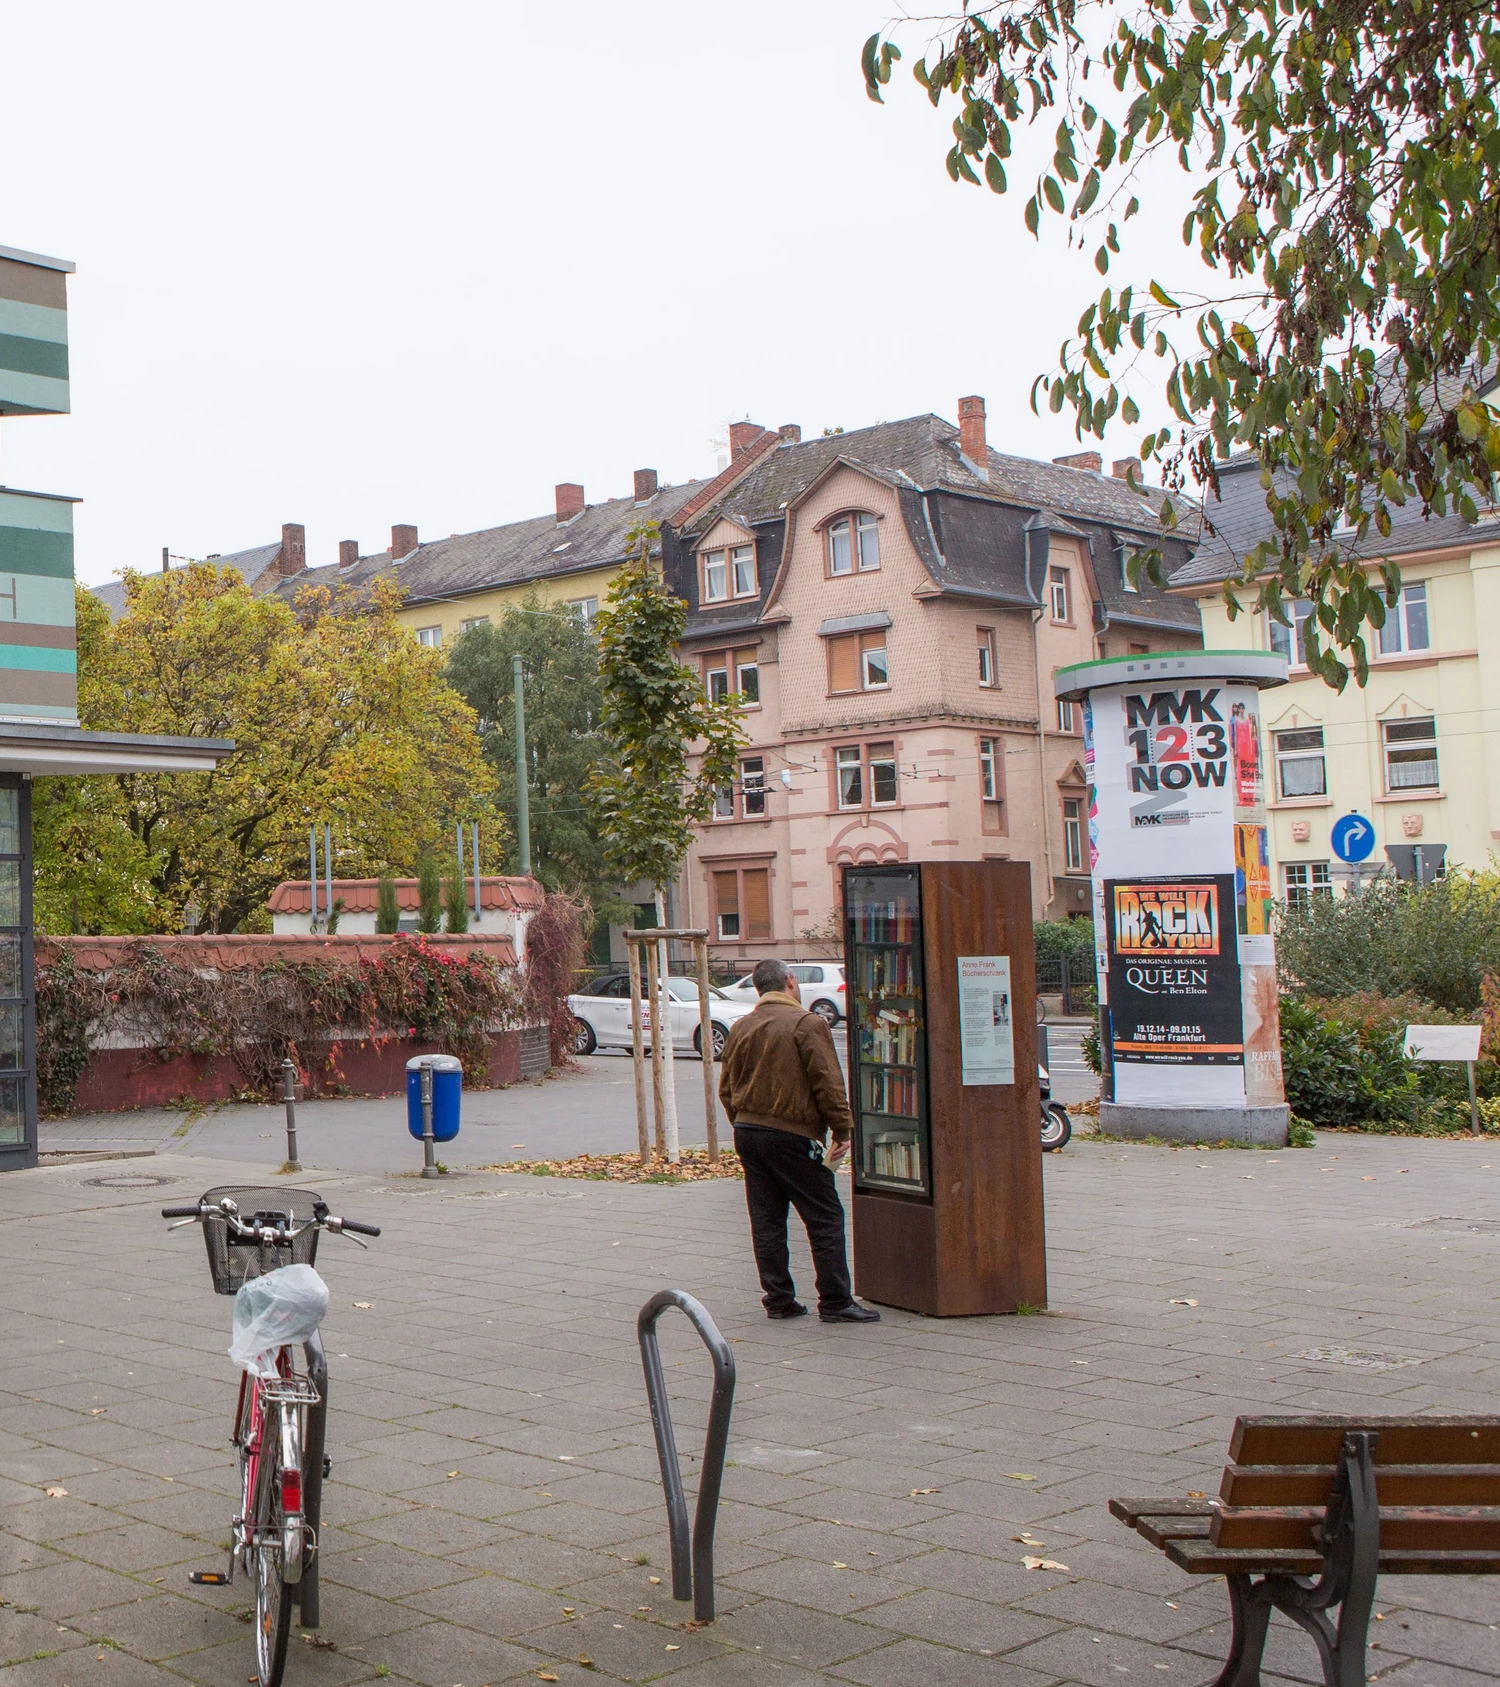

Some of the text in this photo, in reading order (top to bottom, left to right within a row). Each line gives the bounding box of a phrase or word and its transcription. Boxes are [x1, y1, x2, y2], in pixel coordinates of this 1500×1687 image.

[1125, 689, 1224, 728] MMK
[1131, 761, 1228, 792] NOW
[1139, 892, 1185, 901] WE WILL
[1120, 892, 1211, 948] ROCK
[1162, 934, 1212, 948] YOU
[1126, 967, 1208, 994] QUEEN
[1137, 1025, 1165, 1033] 19.12.14
[1148, 1033, 1166, 1042] Oper
